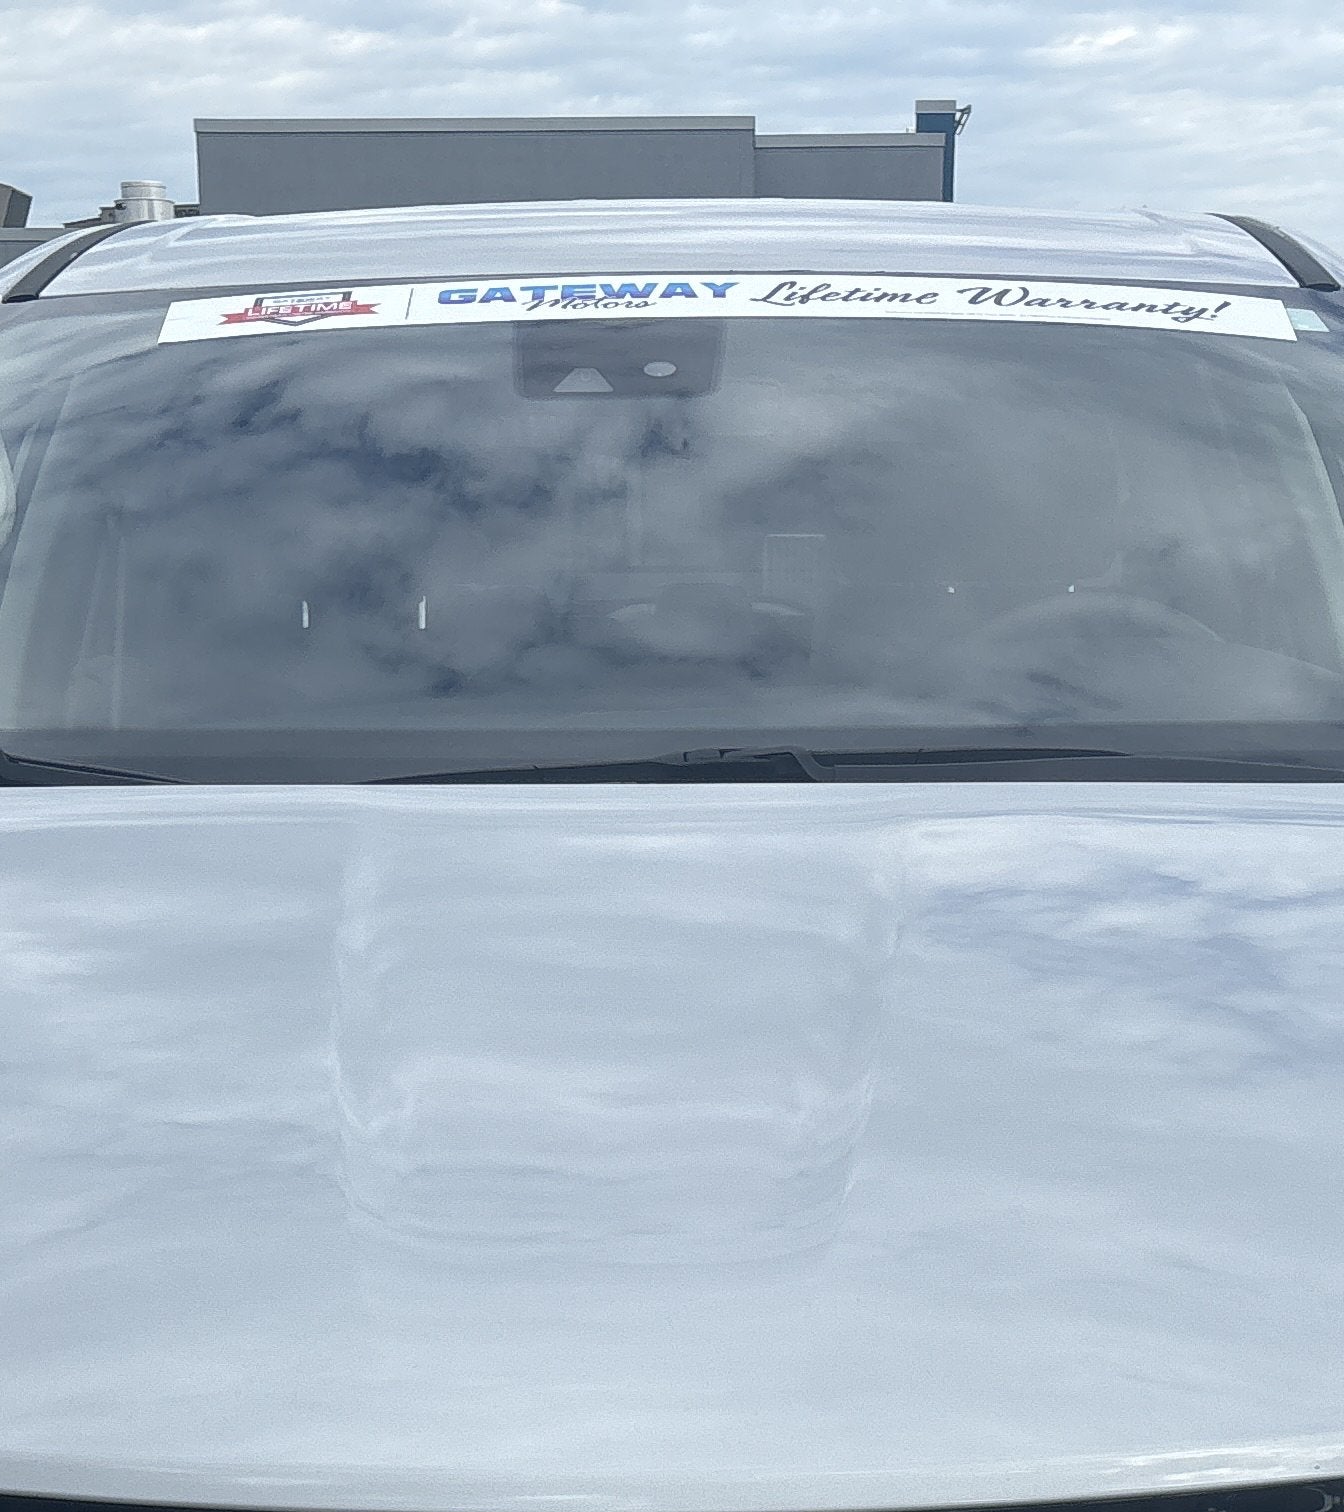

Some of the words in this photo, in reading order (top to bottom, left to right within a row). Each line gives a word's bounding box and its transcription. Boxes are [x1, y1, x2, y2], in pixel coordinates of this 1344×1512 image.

[438, 282, 740, 305] GATEWAY
[750, 281, 939, 306] Lifetime
[956, 286, 1231, 323] Warranty!
[247, 300, 353, 317] LIFETIME
[521, 296, 656, 312] Motors
